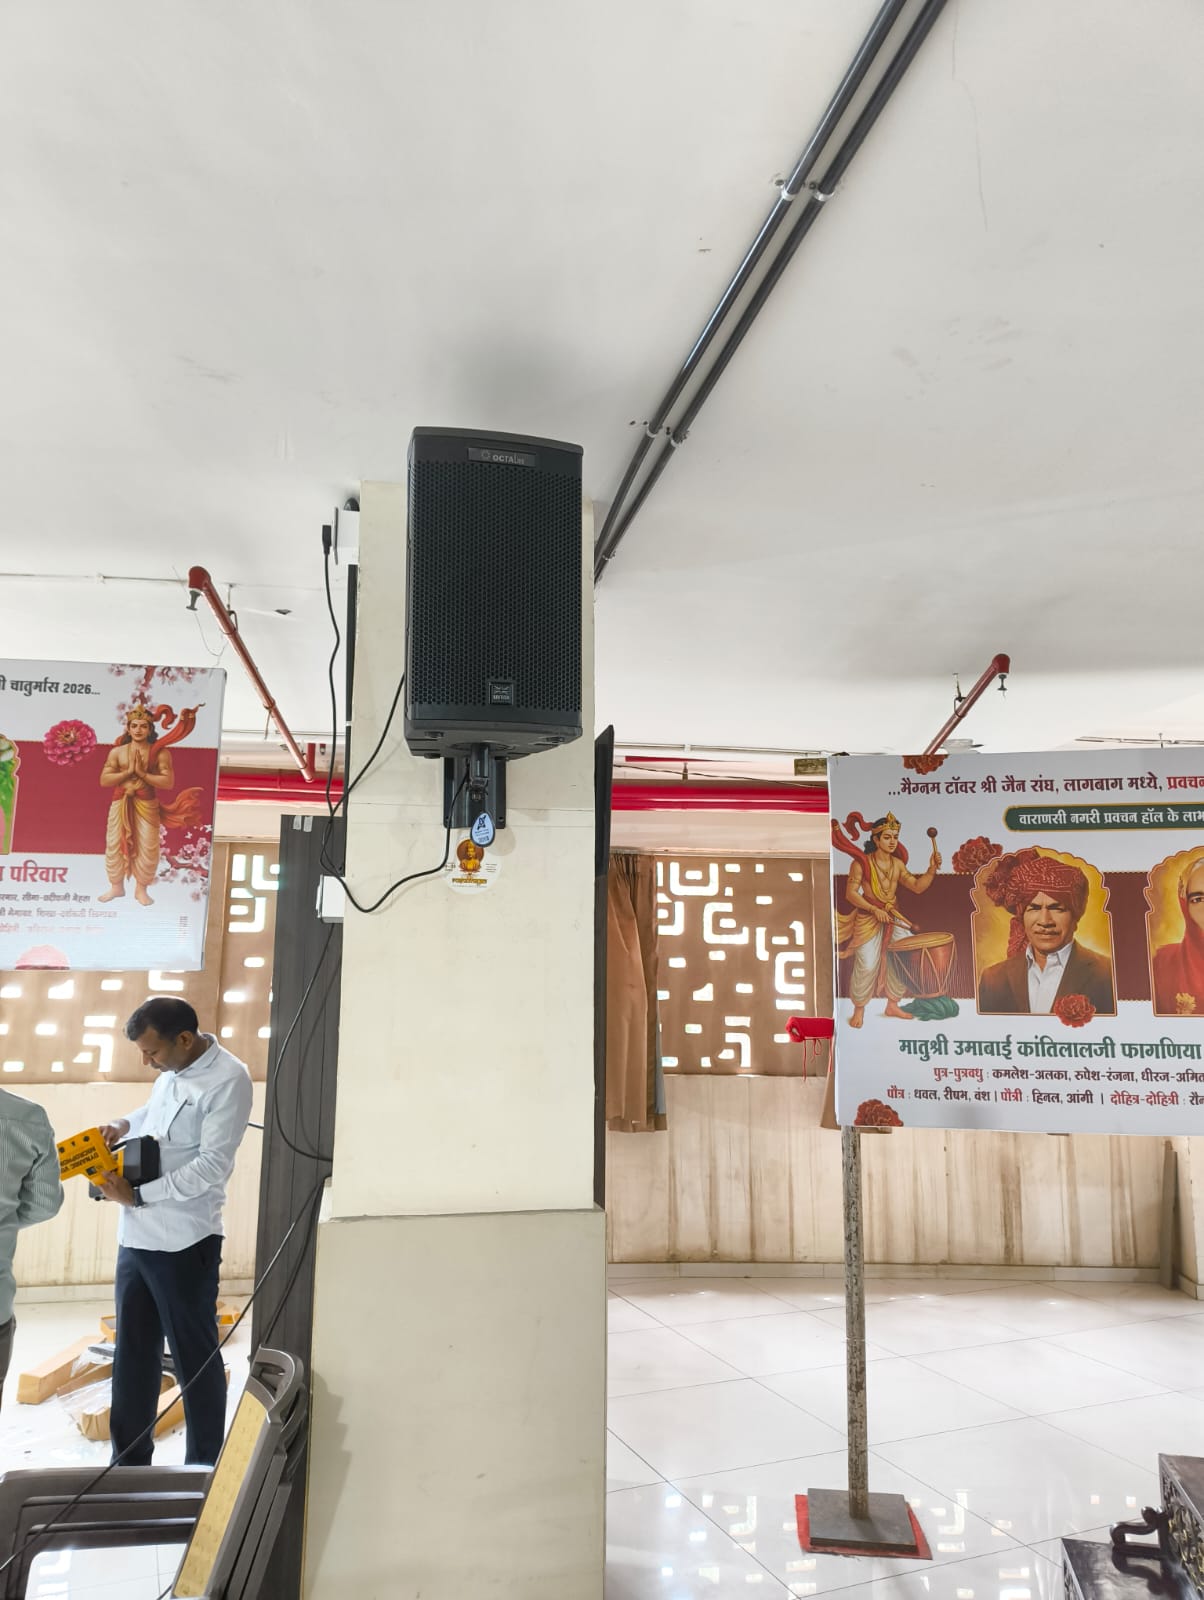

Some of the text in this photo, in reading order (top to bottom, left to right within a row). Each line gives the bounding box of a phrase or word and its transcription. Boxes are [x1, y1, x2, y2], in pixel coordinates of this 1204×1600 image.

[10, 676, 60, 697] चातुर्मास
[945, 776, 976, 794] टॉवर
[981, 775, 997, 794] श्री
[1001, 775, 1026, 793] जैन
[1127, 771, 1162, 793] मध्ये,
[1018, 809, 1067, 825] वाराणसी
[1070, 808, 1100, 824] नगरी
[1104, 811, 1137, 824] प्रवचन
[1141, 808, 1164, 824] हॉल
[1167, 807, 1180, 823] के
[10, 859, 68, 883] परिवार
[899, 1033, 1202, 1062] मातुश्री उमाबाई कांतिलालजी फागणिया
[974, 1086, 991, 1101] वंश
[1000, 1087, 1022, 1103] पौत्री
[71, 1151, 100, 1170] DYNAMIC
